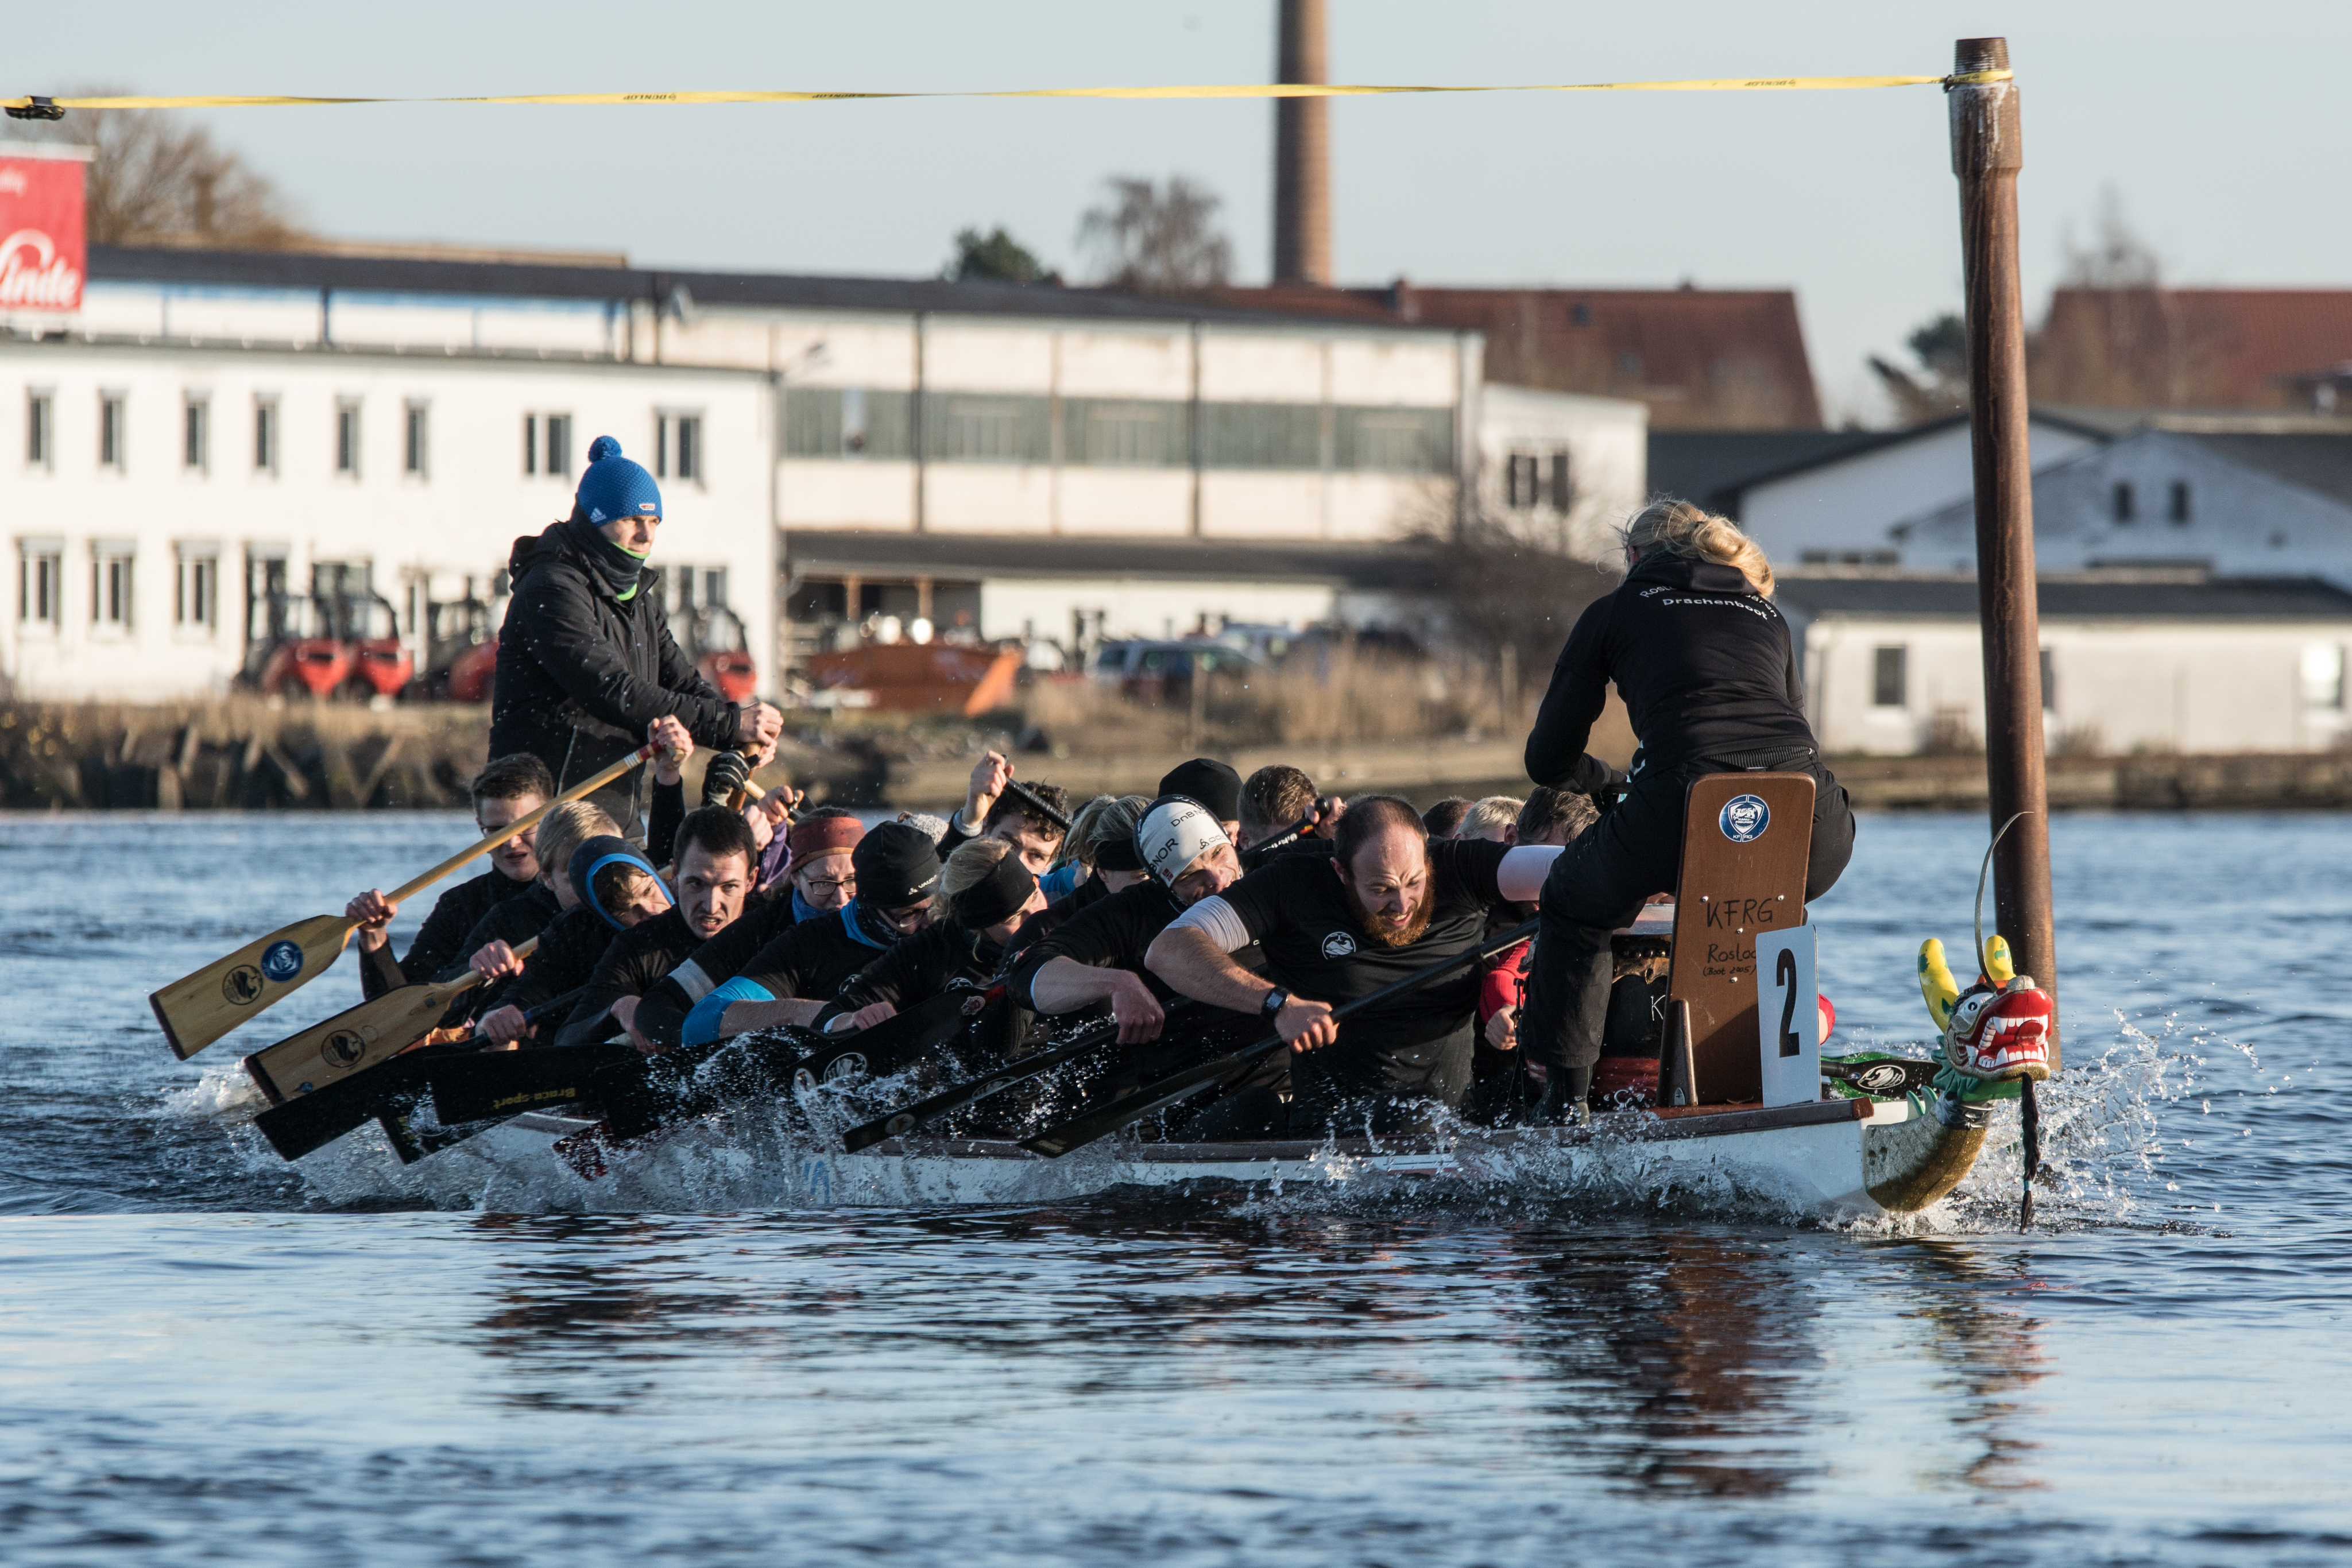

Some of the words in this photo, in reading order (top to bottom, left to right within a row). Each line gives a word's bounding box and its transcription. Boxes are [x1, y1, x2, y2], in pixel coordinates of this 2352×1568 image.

[1639, 586, 1677, 598] Rost
[1662, 598, 1768, 620] Drachenboot
[1707, 898, 1773, 930] KFRG
[1703, 966, 1726, 977] (Boot
[1776, 948, 1800, 1058] 2
